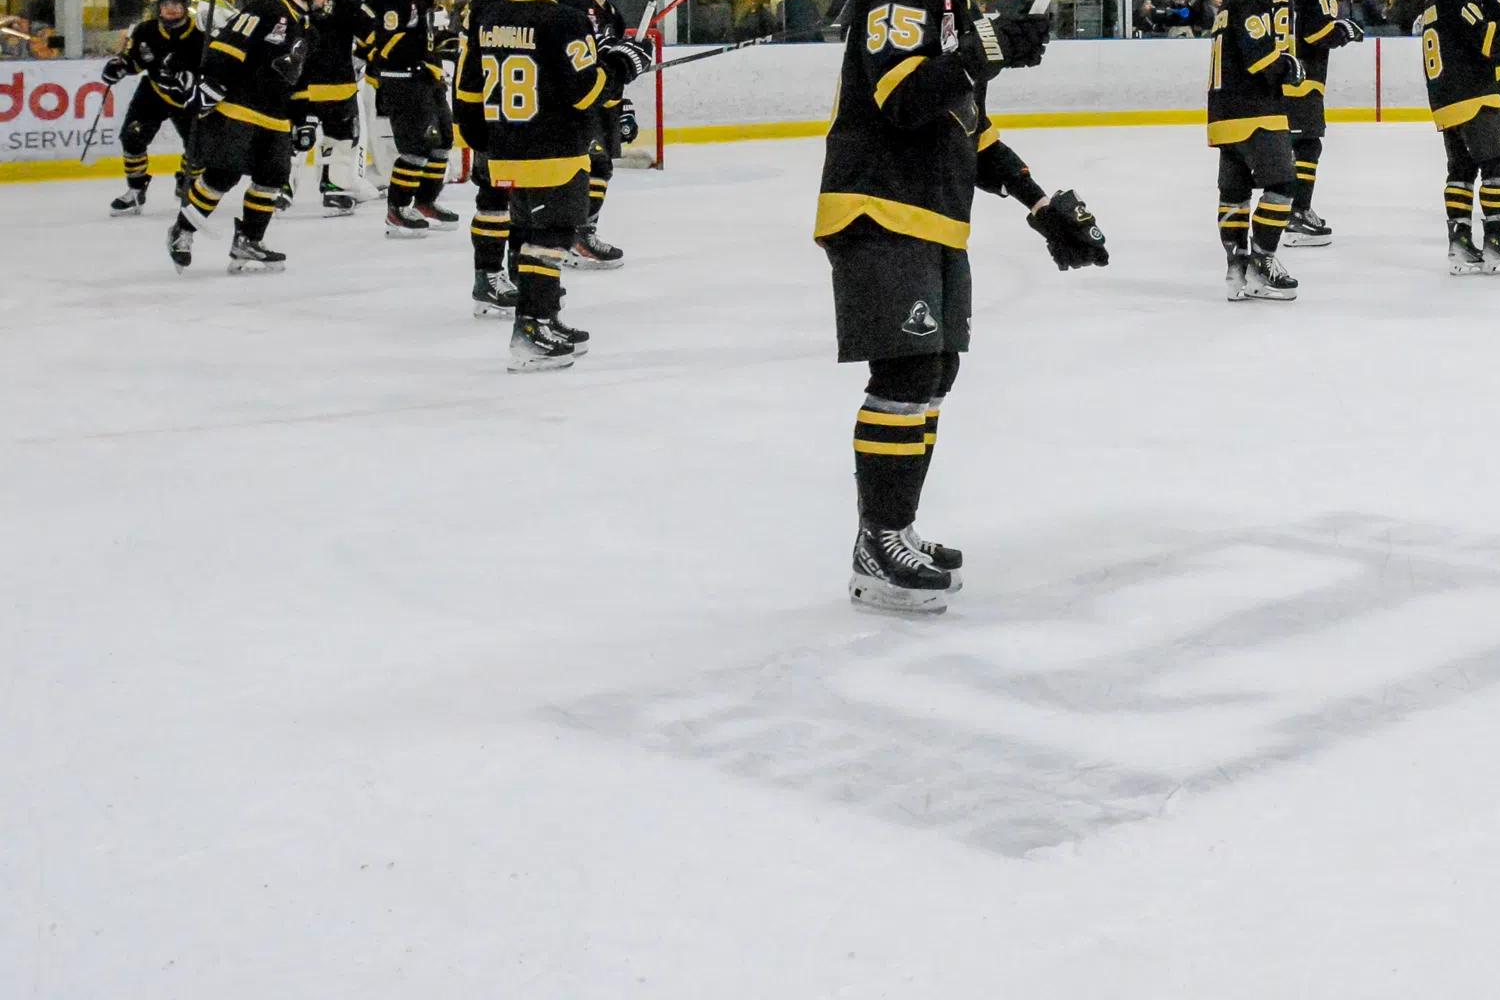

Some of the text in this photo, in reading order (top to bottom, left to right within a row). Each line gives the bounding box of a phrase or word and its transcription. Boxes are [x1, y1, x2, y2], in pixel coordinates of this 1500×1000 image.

[232, 12, 261, 37] 11
[384, 10, 399, 30] 9
[867, 2, 927, 54] 55
[481, 54, 539, 122] 28
[9, 128, 115, 150] SERVICE
[357, 147, 365, 178] CCM
